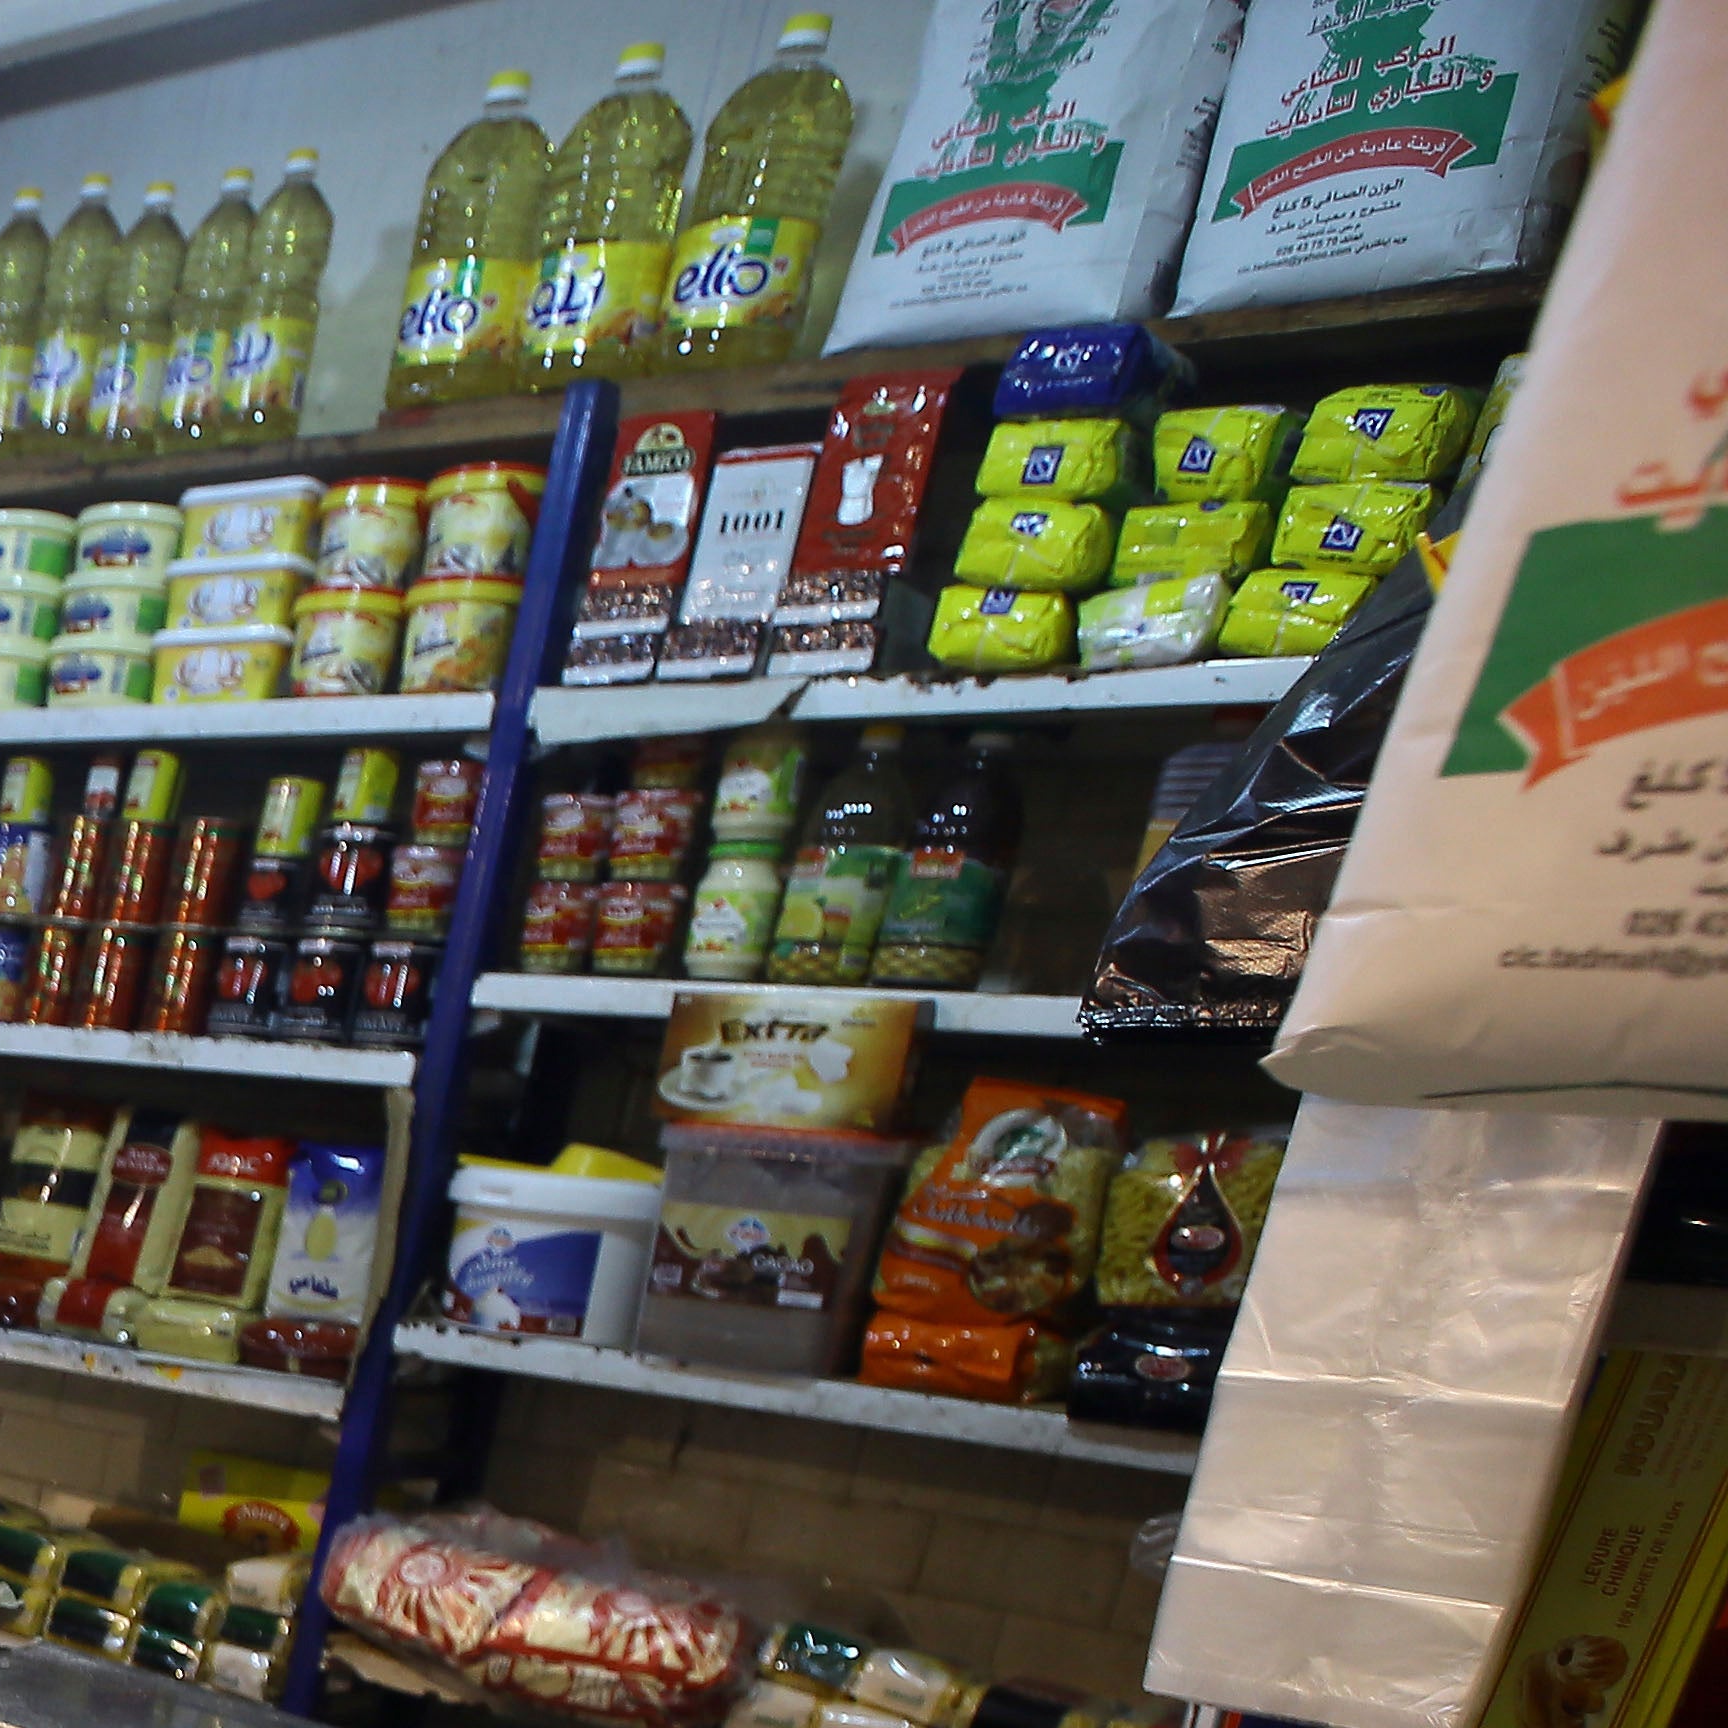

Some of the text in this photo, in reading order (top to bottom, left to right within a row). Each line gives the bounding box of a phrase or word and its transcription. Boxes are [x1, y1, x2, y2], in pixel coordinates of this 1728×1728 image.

[1281, 35, 1455, 105] المركب الصناعي
[1369, 66, 1465, 111] التجاري
[1406, 133, 1447, 157] فرينة
[673, 245, 769, 302] elio
[719, 509, 786, 535] 1001
[1615, 1352, 1688, 1478] NOUAR
[1584, 1527, 1619, 1588] LEVURE
[1601, 1523, 1646, 1597] CHIMIQUE
